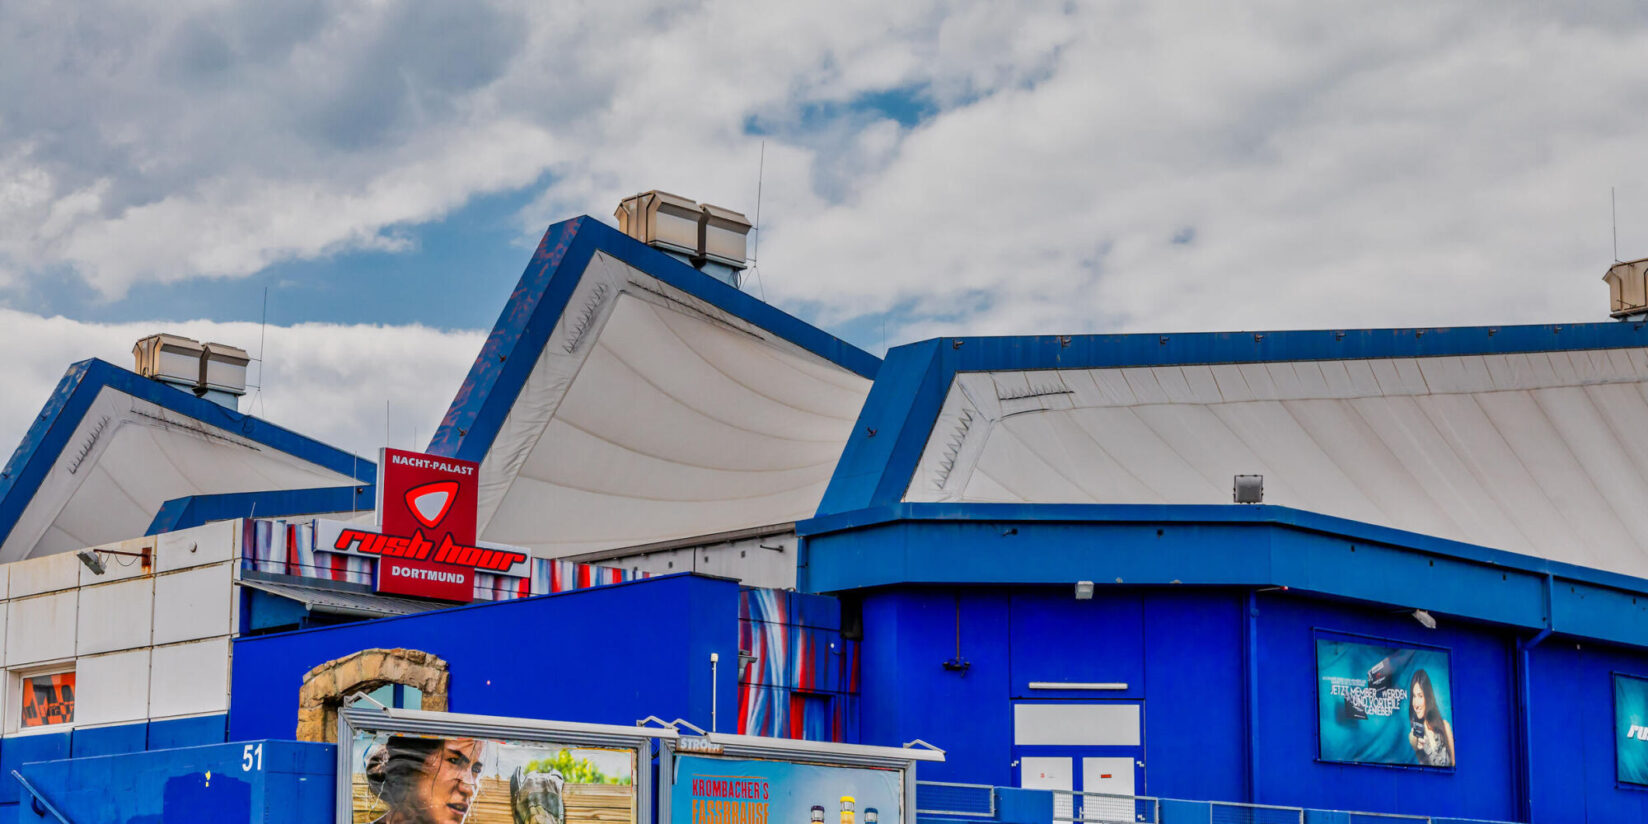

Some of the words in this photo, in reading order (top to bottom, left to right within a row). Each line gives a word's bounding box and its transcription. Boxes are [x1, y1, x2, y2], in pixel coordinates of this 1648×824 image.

[334, 527, 435, 561] rush
[432, 531, 527, 572] hour
[391, 565, 465, 584] DORTMUND
[1330, 685, 1349, 695] JETZT
[1350, 687, 1377, 697] MEMBER
[1382, 688, 1407, 699] WERDEN
[1368, 697, 1400, 709] VORTEILE
[1626, 724, 1648, 741] ru
[242, 743, 263, 772] 51
[692, 778, 769, 800] KROMBACHER'S
